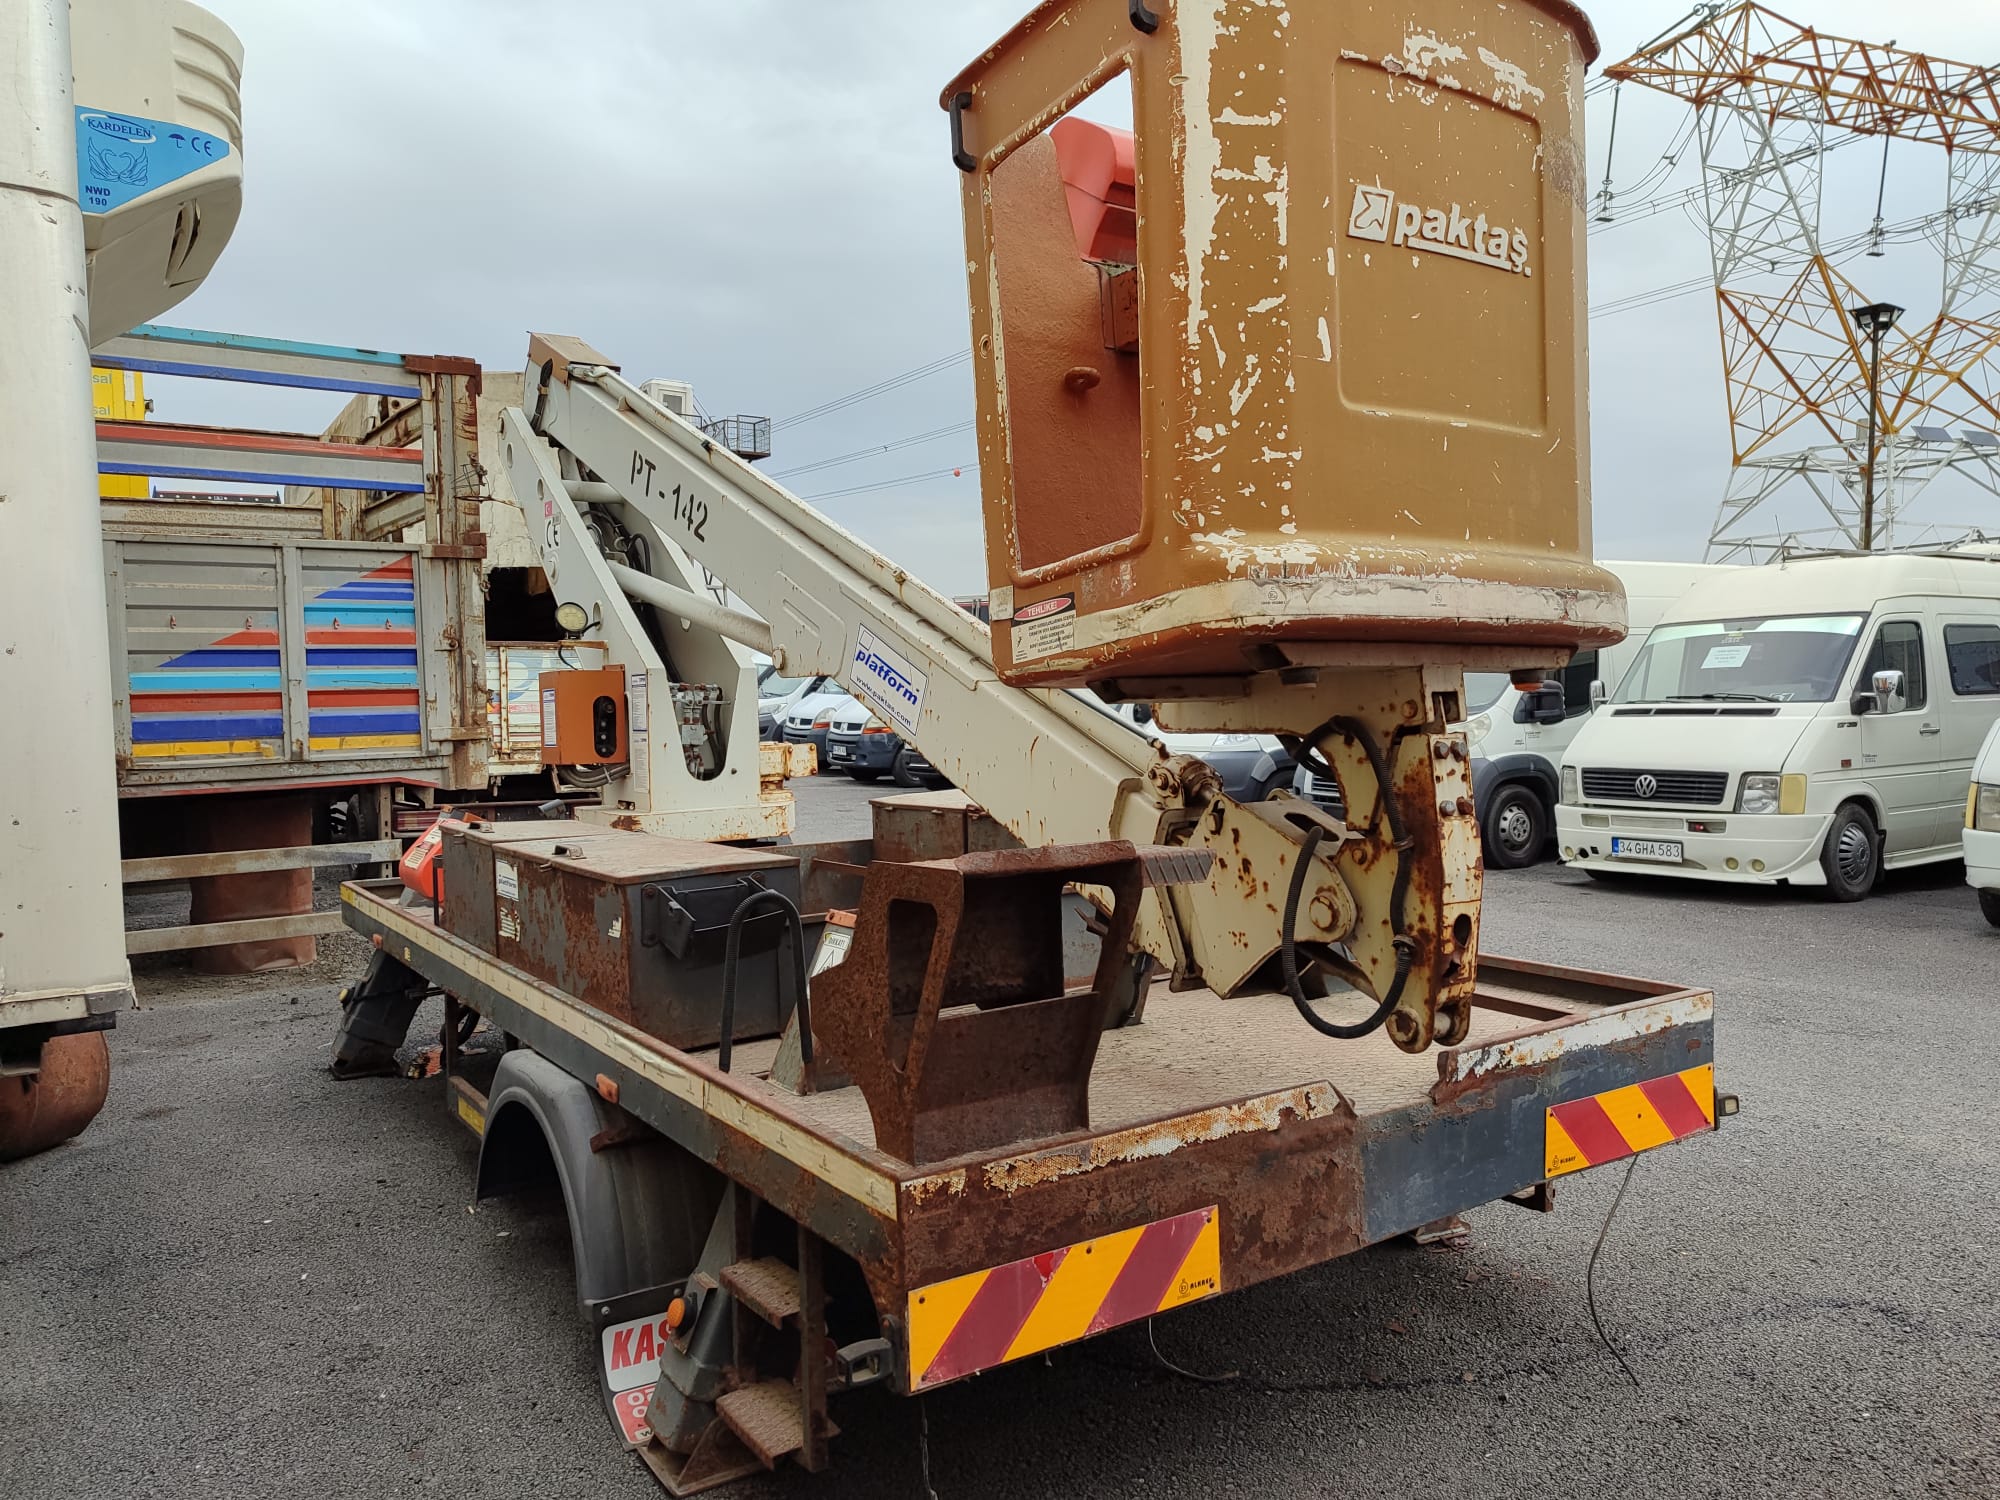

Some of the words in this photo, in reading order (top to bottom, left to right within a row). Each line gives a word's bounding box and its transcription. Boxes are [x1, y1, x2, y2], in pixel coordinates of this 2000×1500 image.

[87, 118, 151, 138] KARDELEN
[85, 185, 111, 196] NWD
[88, 196, 108, 207] 190
[855, 649, 919, 706] platform
[1619, 841, 1633, 854] 34
[1634, 842, 1656, 856] GHA
[1658, 844, 1681, 858] 583
